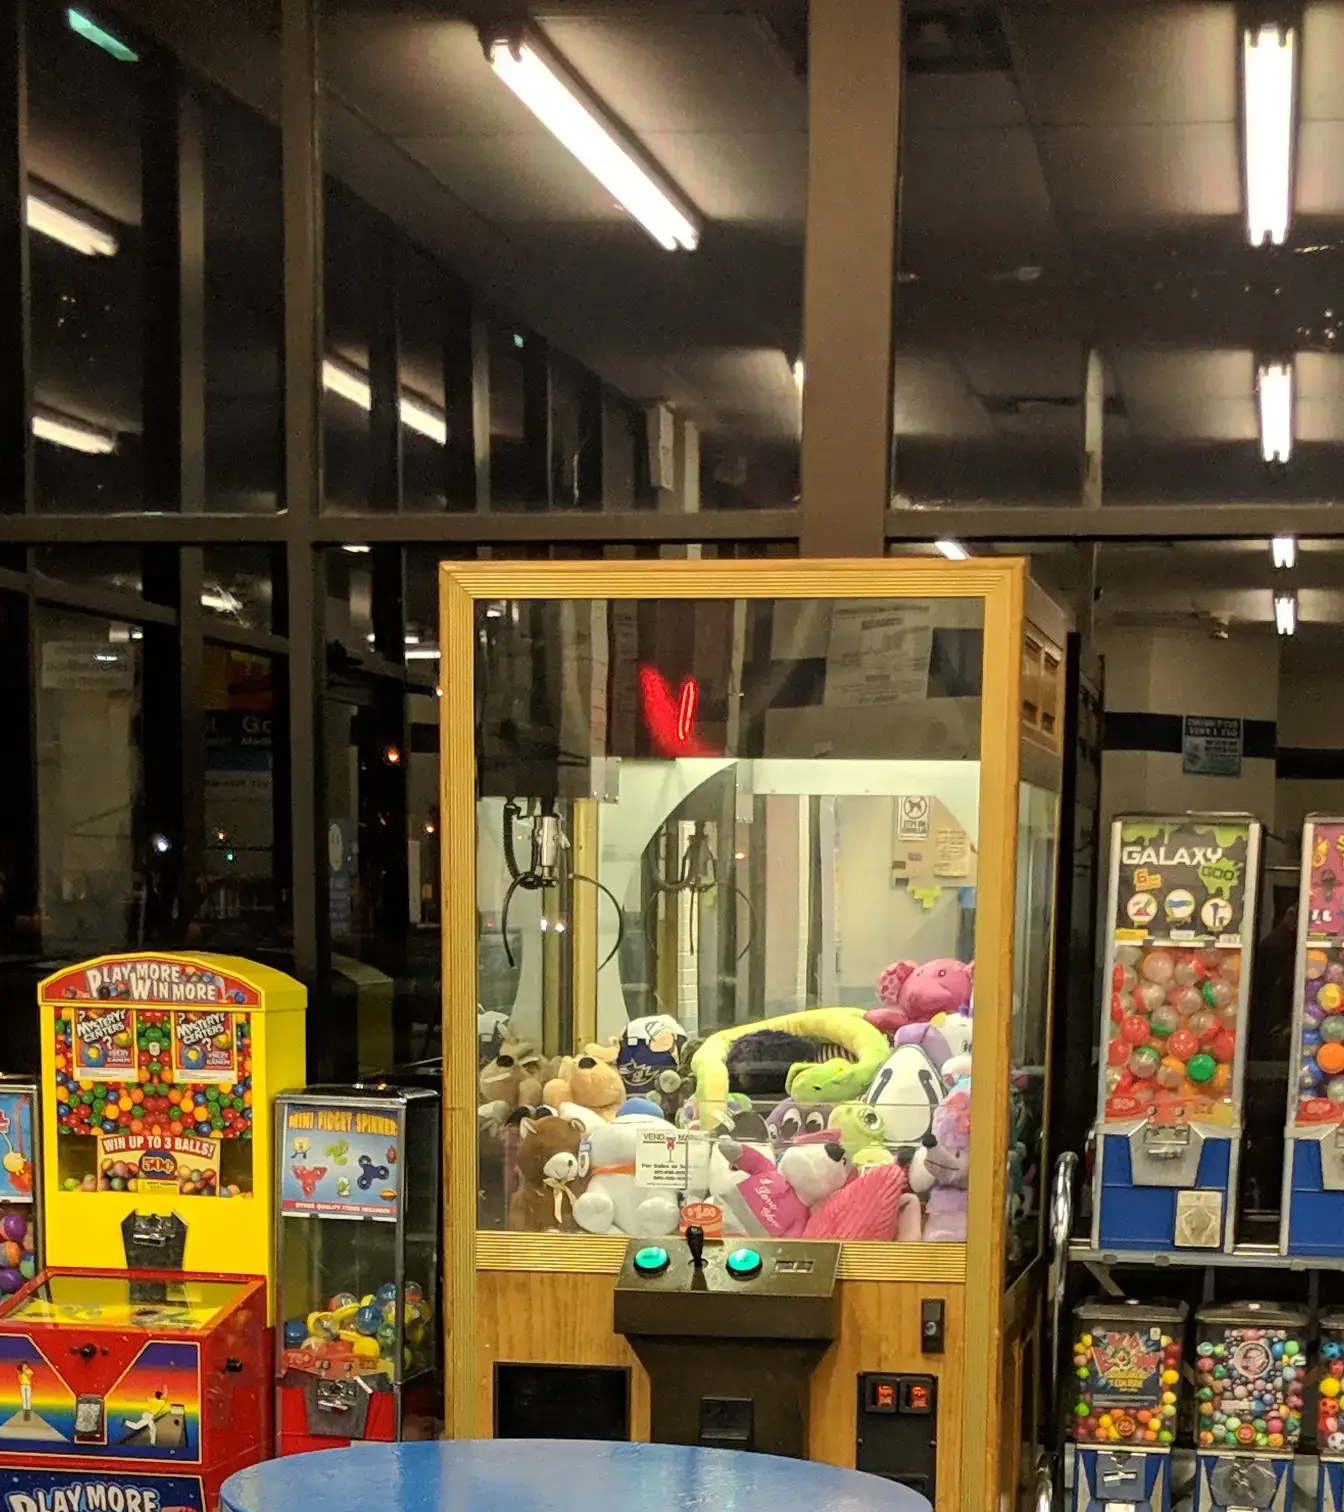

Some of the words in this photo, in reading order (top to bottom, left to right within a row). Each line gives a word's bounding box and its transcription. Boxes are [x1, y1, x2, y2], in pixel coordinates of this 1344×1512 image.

[1122, 846, 1222, 865] GALAXY
[1201, 866, 1235, 881] GOO
[86, 965, 131, 999] PLAY
[136, 963, 181, 983] MORE
[130, 972, 169, 1000] WIN
[172, 983, 217, 1000] MORE
[84, 1022, 125, 1043] CENTERS
[183, 1024, 224, 1044] CENTERS
[317, 1111, 352, 1132] FIDGET
[103, 1136, 126, 1152] WIN
[128, 1136, 144, 1149] UP
[148, 1136, 161, 1148] TO
[164, 1136, 172, 1149] 3
[175, 1137, 215, 1157] BALLS!
[142, 1157, 175, 1174] 50¢
